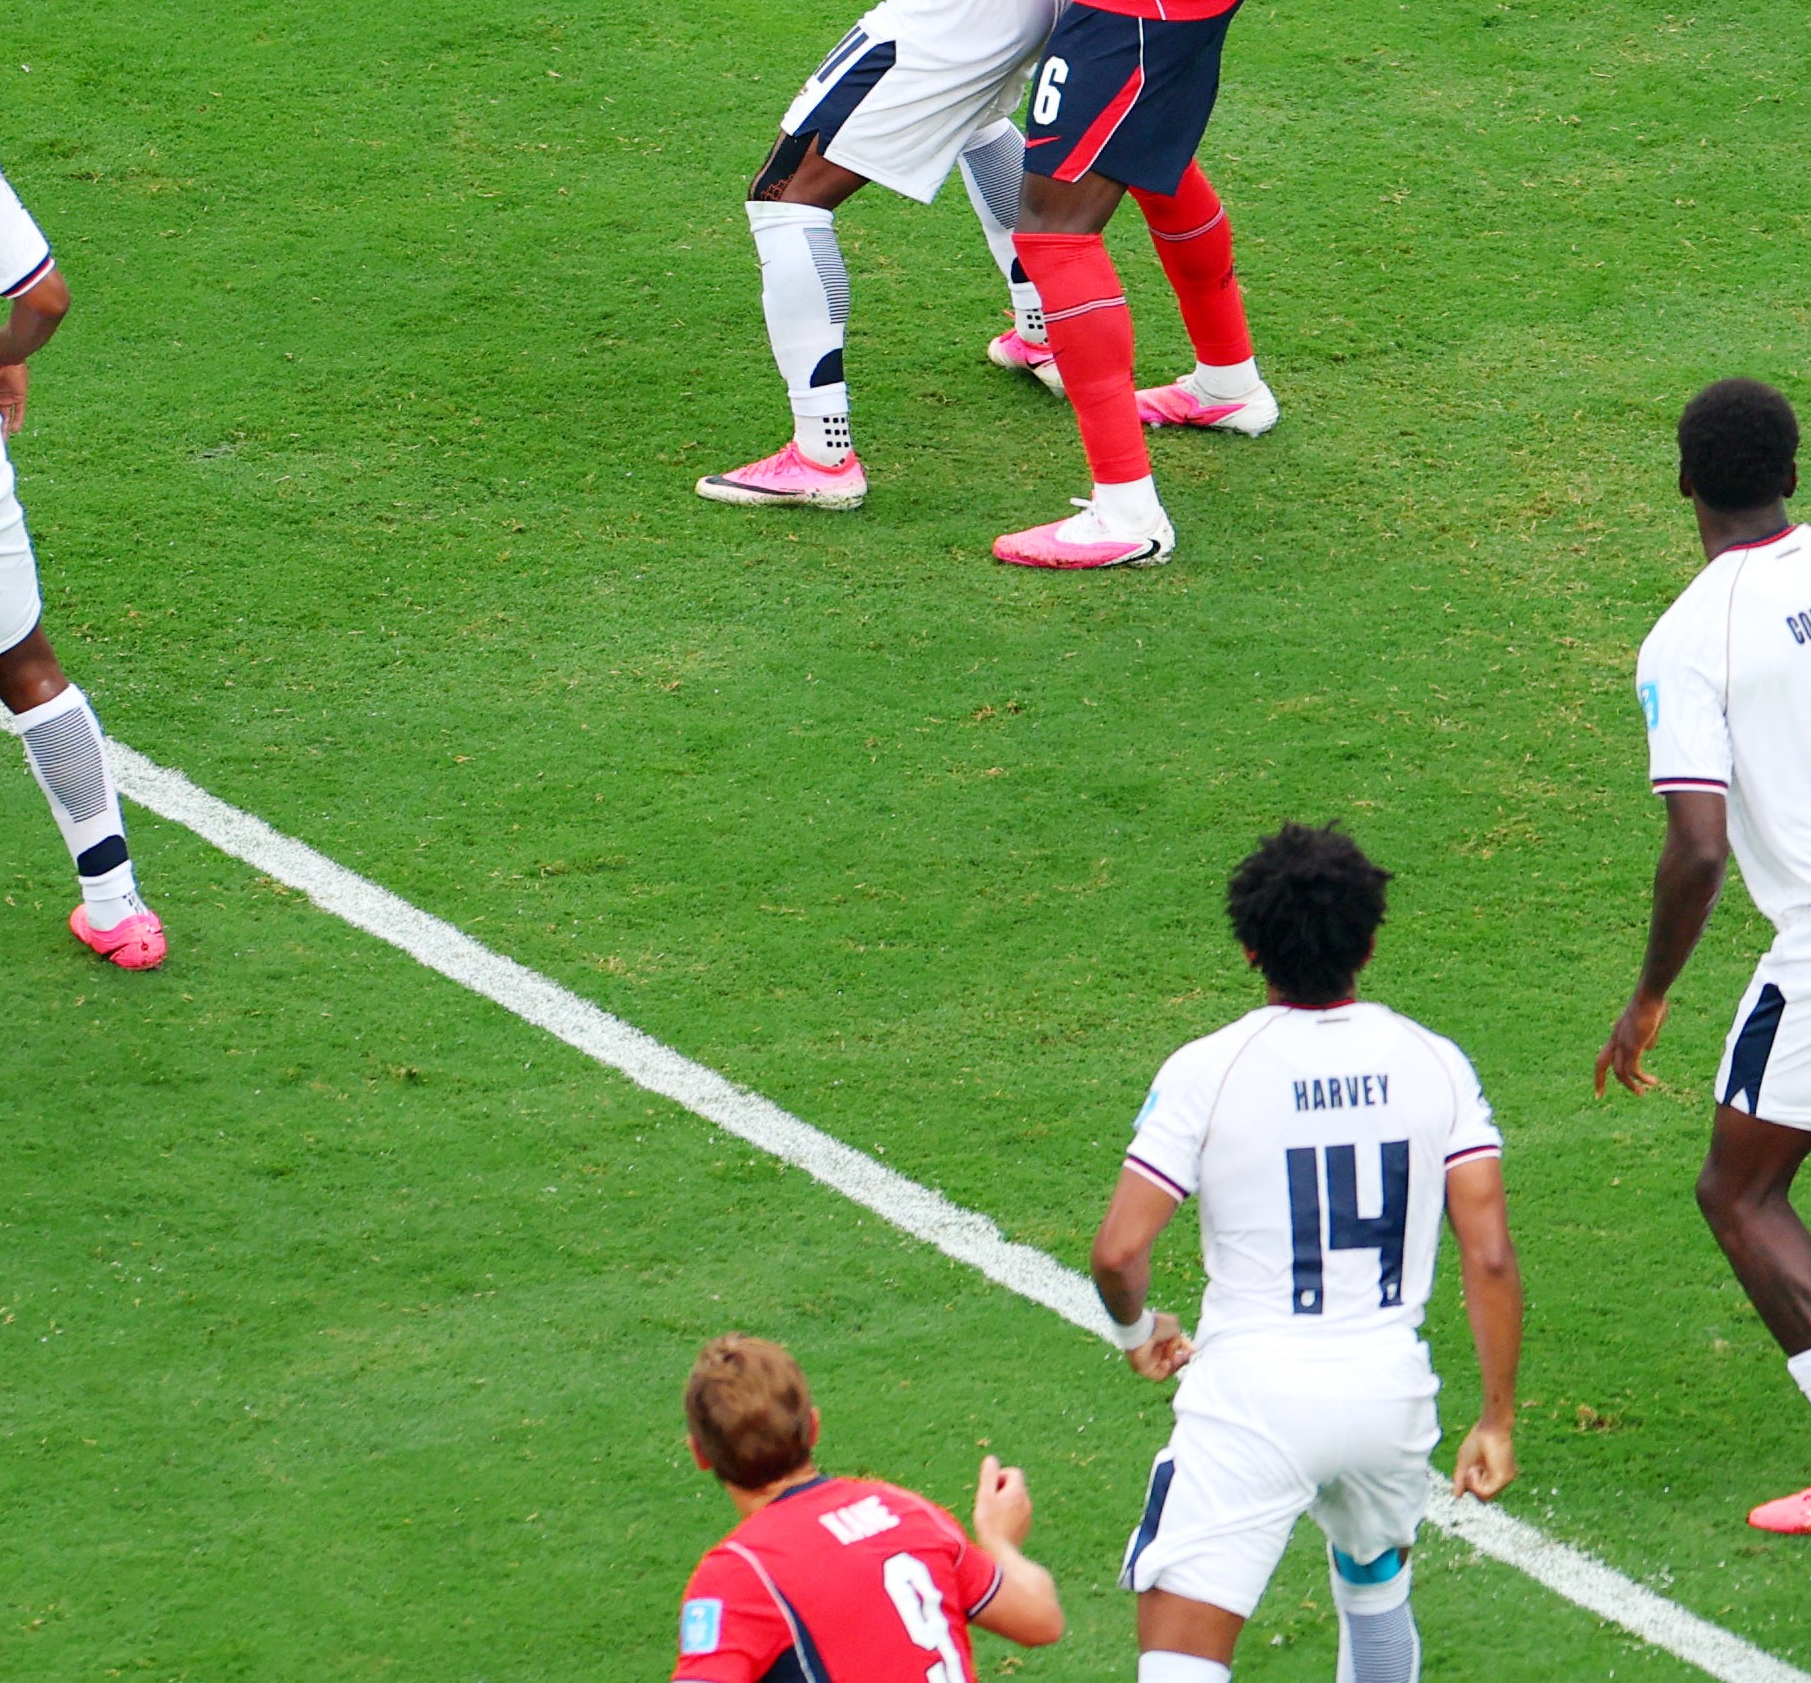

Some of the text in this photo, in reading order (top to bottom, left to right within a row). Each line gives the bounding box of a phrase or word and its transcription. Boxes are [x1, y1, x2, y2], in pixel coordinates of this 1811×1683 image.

[1032, 55, 1070, 126] 6
[1293, 1073, 1390, 1113] HARVEY
[1286, 1139, 1412, 1316] 14
[881, 1550, 968, 1683] 9
